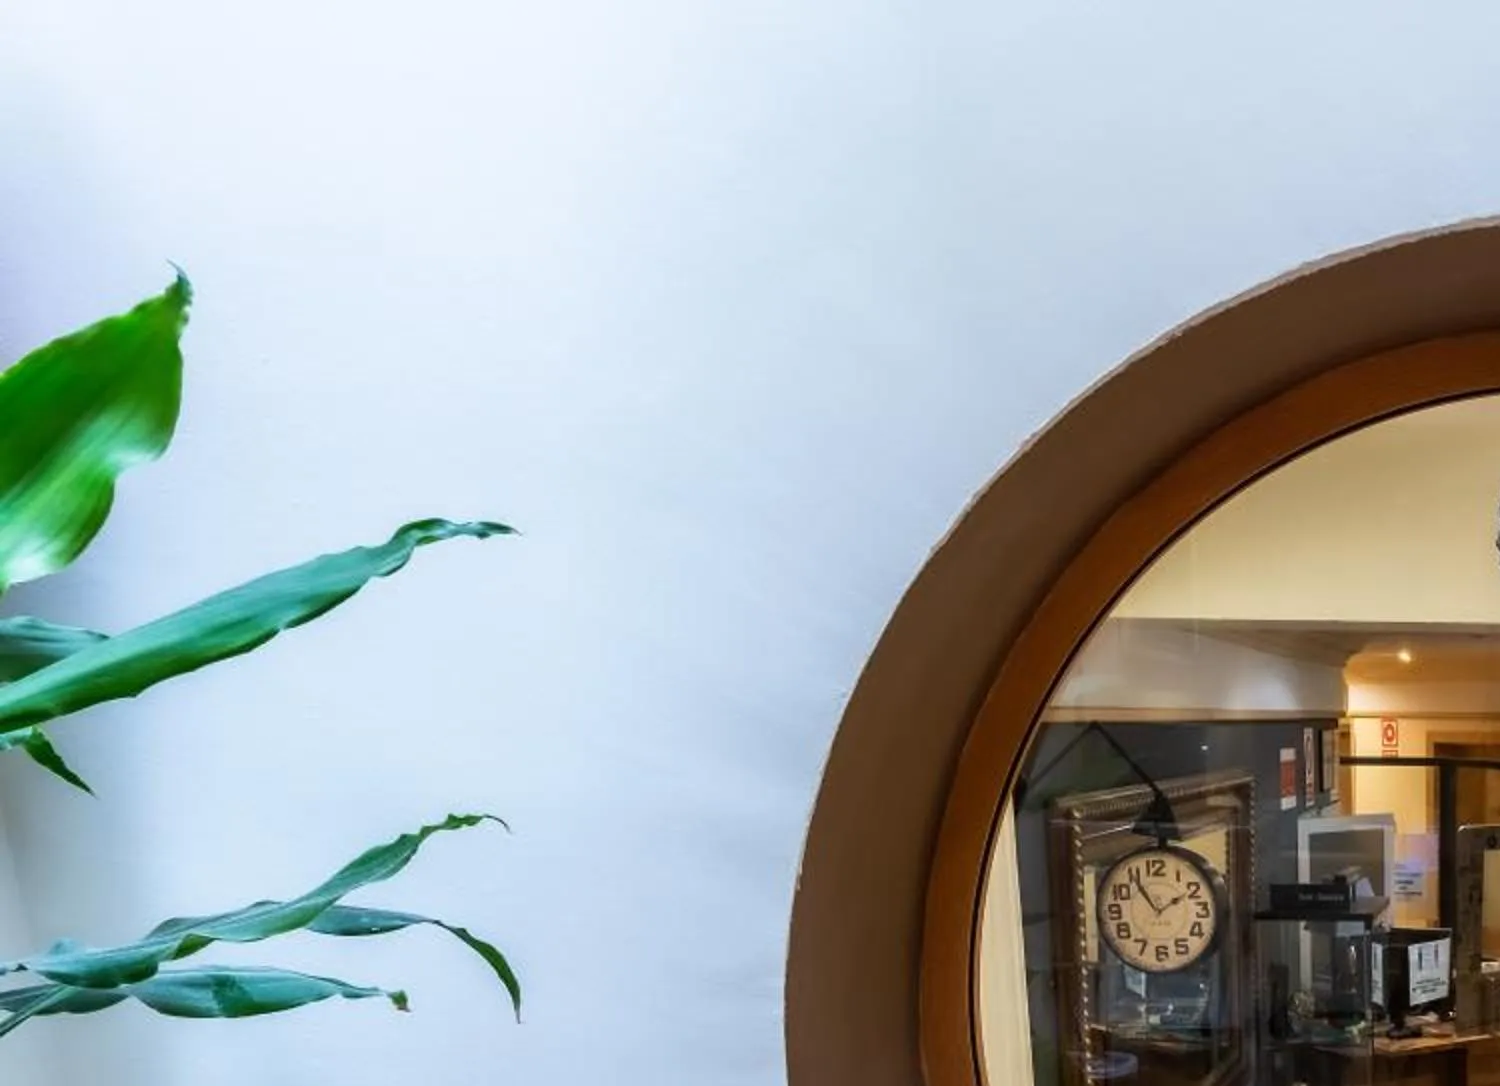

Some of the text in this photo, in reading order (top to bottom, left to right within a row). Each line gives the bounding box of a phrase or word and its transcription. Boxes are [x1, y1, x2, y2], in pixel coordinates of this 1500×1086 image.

[1145, 860, 1167, 877] 12
[1112, 883, 1131, 901] 10
[1187, 882, 1201, 899] 2
[1108, 904, 1122, 920] 9
[1195, 902, 1210, 919] 3
[1116, 922, 1131, 939] 8
[1189, 922, 1204, 938] 4
[1132, 939, 1148, 956] 7
[1155, 945, 1170, 962] 6
[1174, 938, 1189, 955] 5
